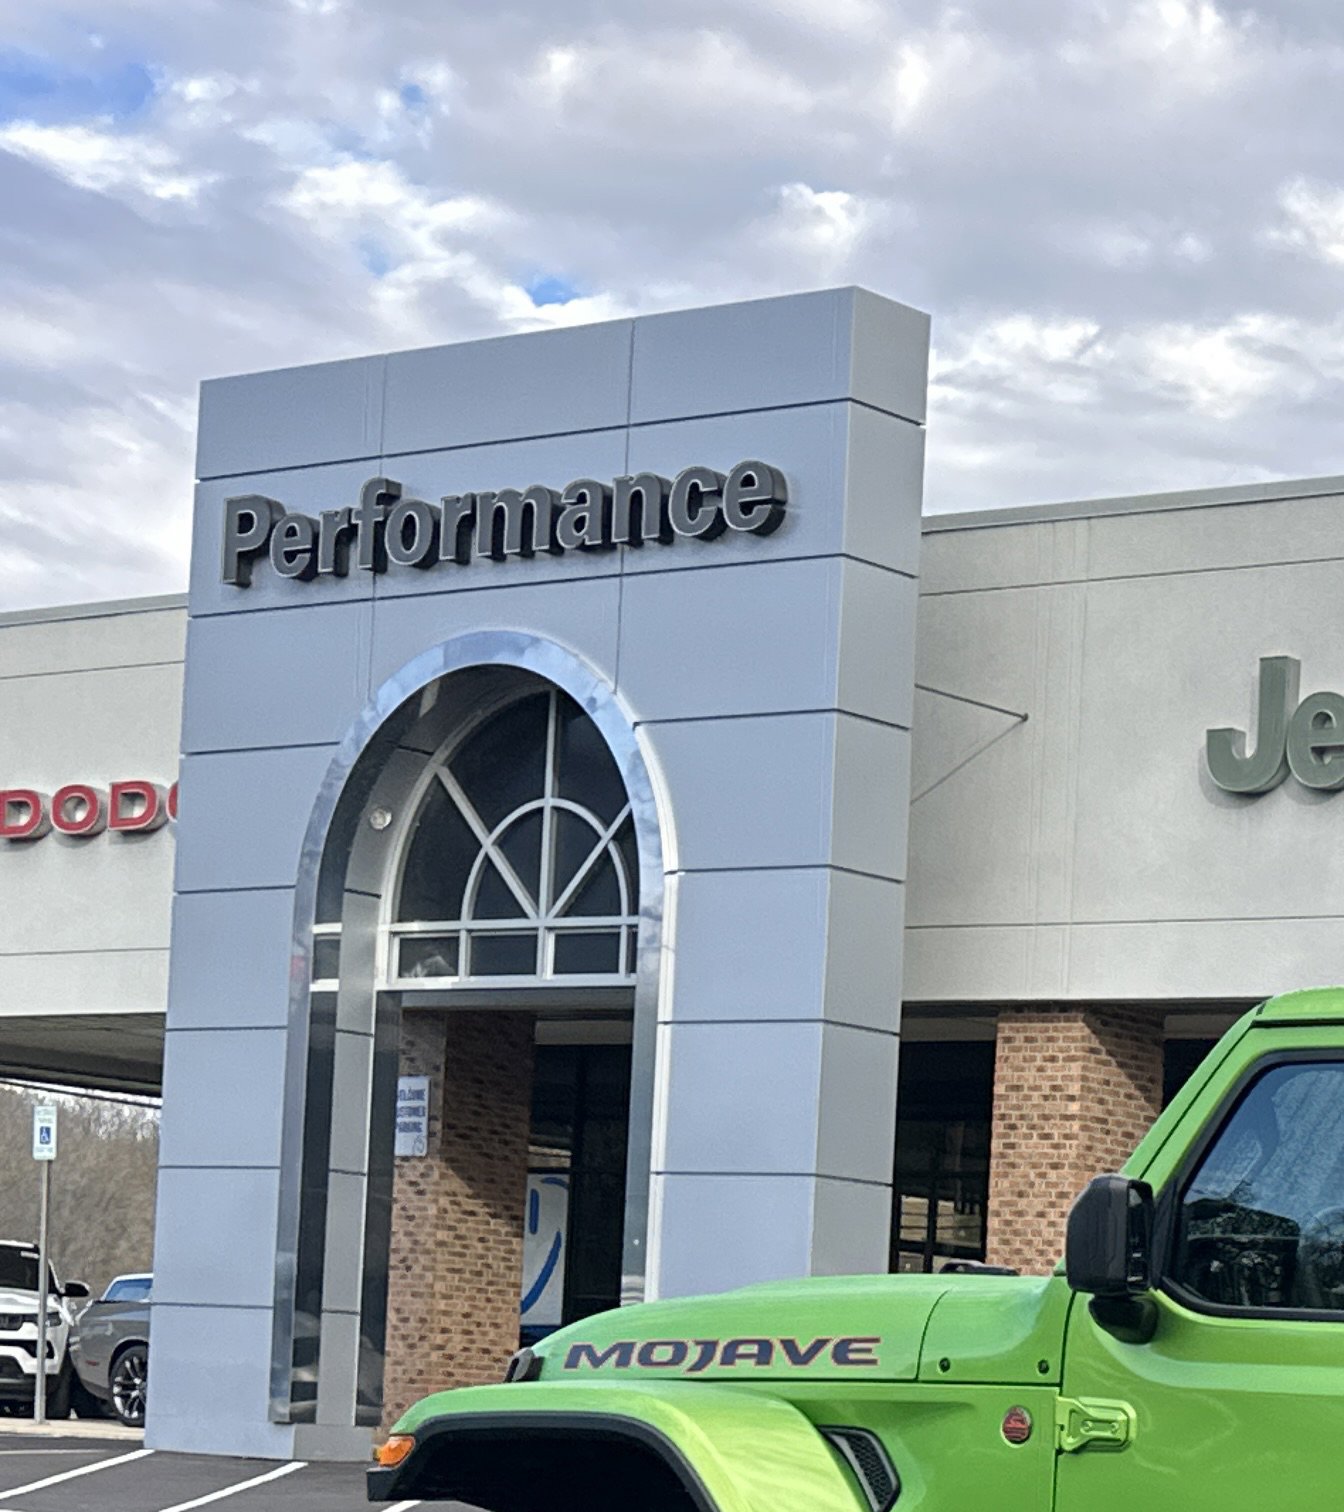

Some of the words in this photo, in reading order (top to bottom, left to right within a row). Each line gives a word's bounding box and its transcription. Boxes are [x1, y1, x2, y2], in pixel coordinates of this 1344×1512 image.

[220, 459, 789, 588] Performance
[0, 780, 179, 840] DOD
[562, 1335, 882, 1375] MOJAVE
